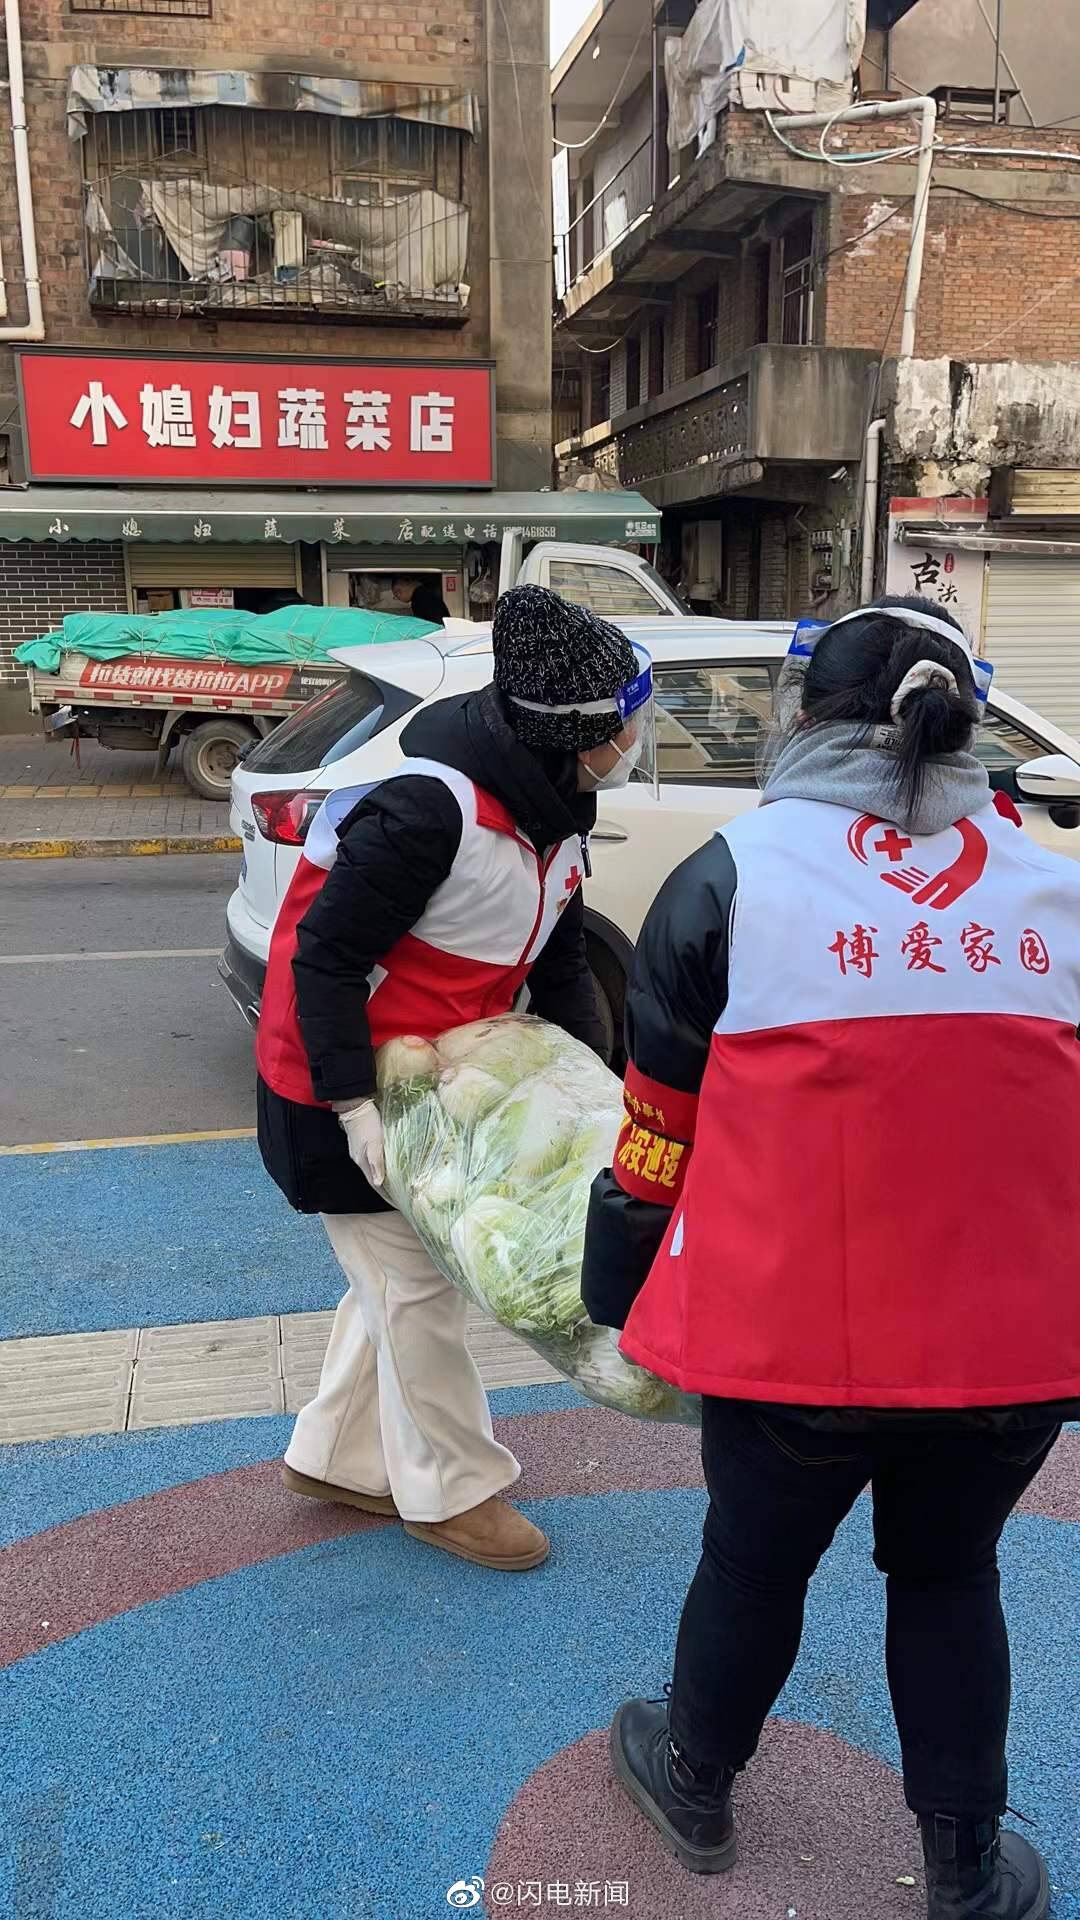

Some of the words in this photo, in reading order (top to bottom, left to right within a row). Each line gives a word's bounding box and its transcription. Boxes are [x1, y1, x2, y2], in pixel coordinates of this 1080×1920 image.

[69, 381, 456, 453] 小媳妇蔬菜店
[48, 518, 414, 540] 小媳妇蔬菜店
[420, 523, 498, 538] 配送电话
[88, 664, 284, 694] 拉货就找货拉拉APP
[826, 921, 1050, 978] 博爱家园
